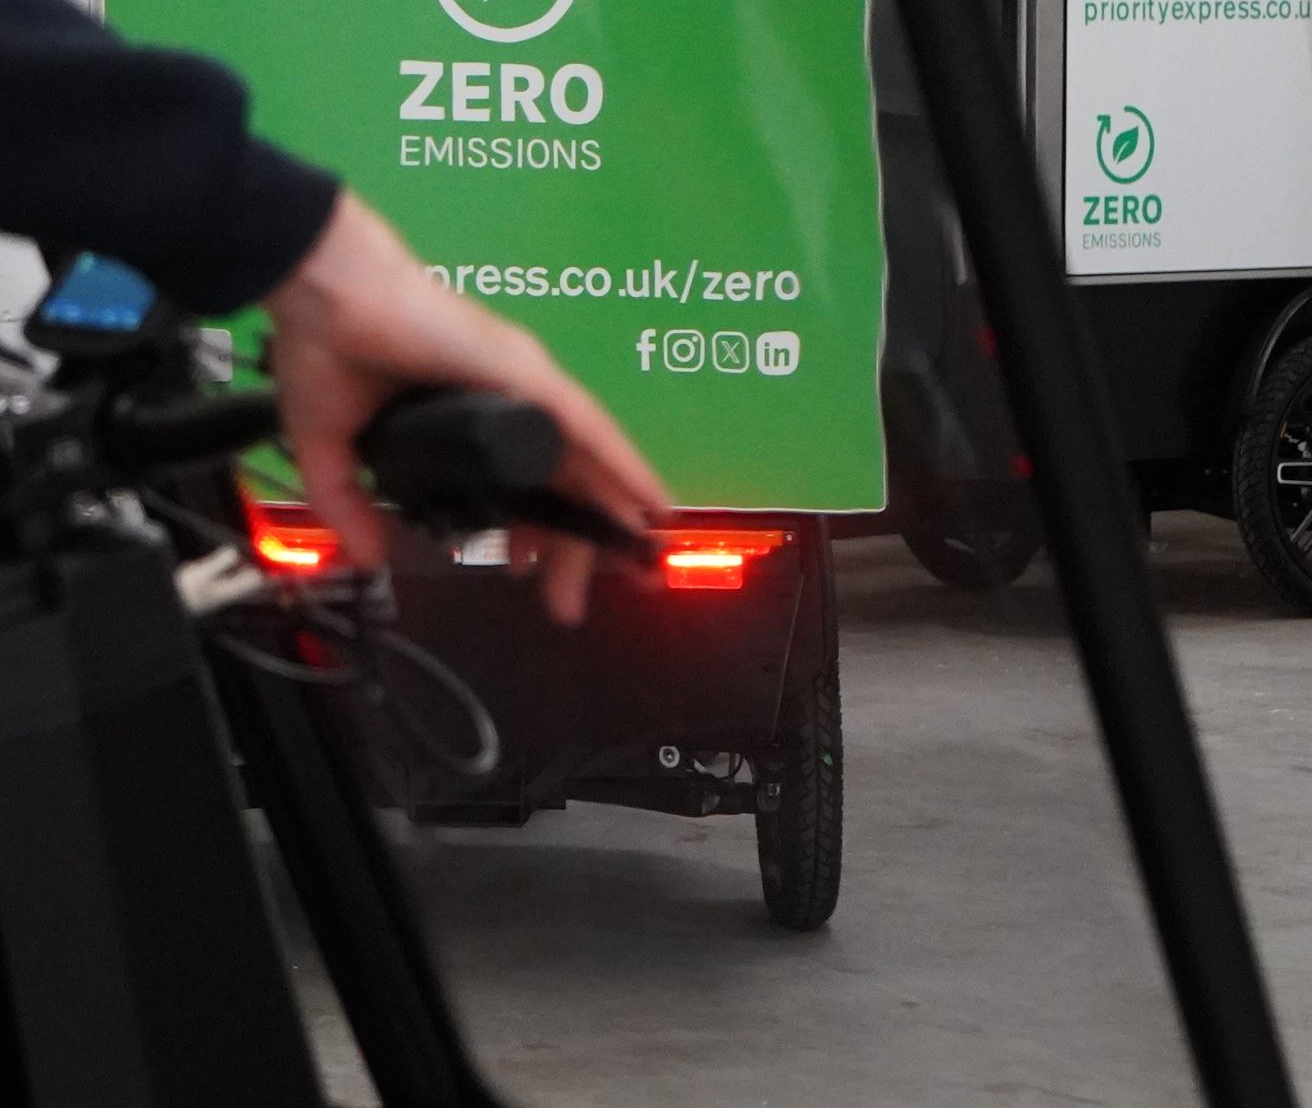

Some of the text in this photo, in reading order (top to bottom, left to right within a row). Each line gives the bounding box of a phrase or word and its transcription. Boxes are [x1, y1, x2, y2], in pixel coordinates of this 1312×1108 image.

[398, 59, 604, 126] ZERO
[398, 135, 603, 171] EMISSIONS
[1083, 195, 1163, 225] ZERO
[1082, 231, 1163, 250] EMISSIONS
